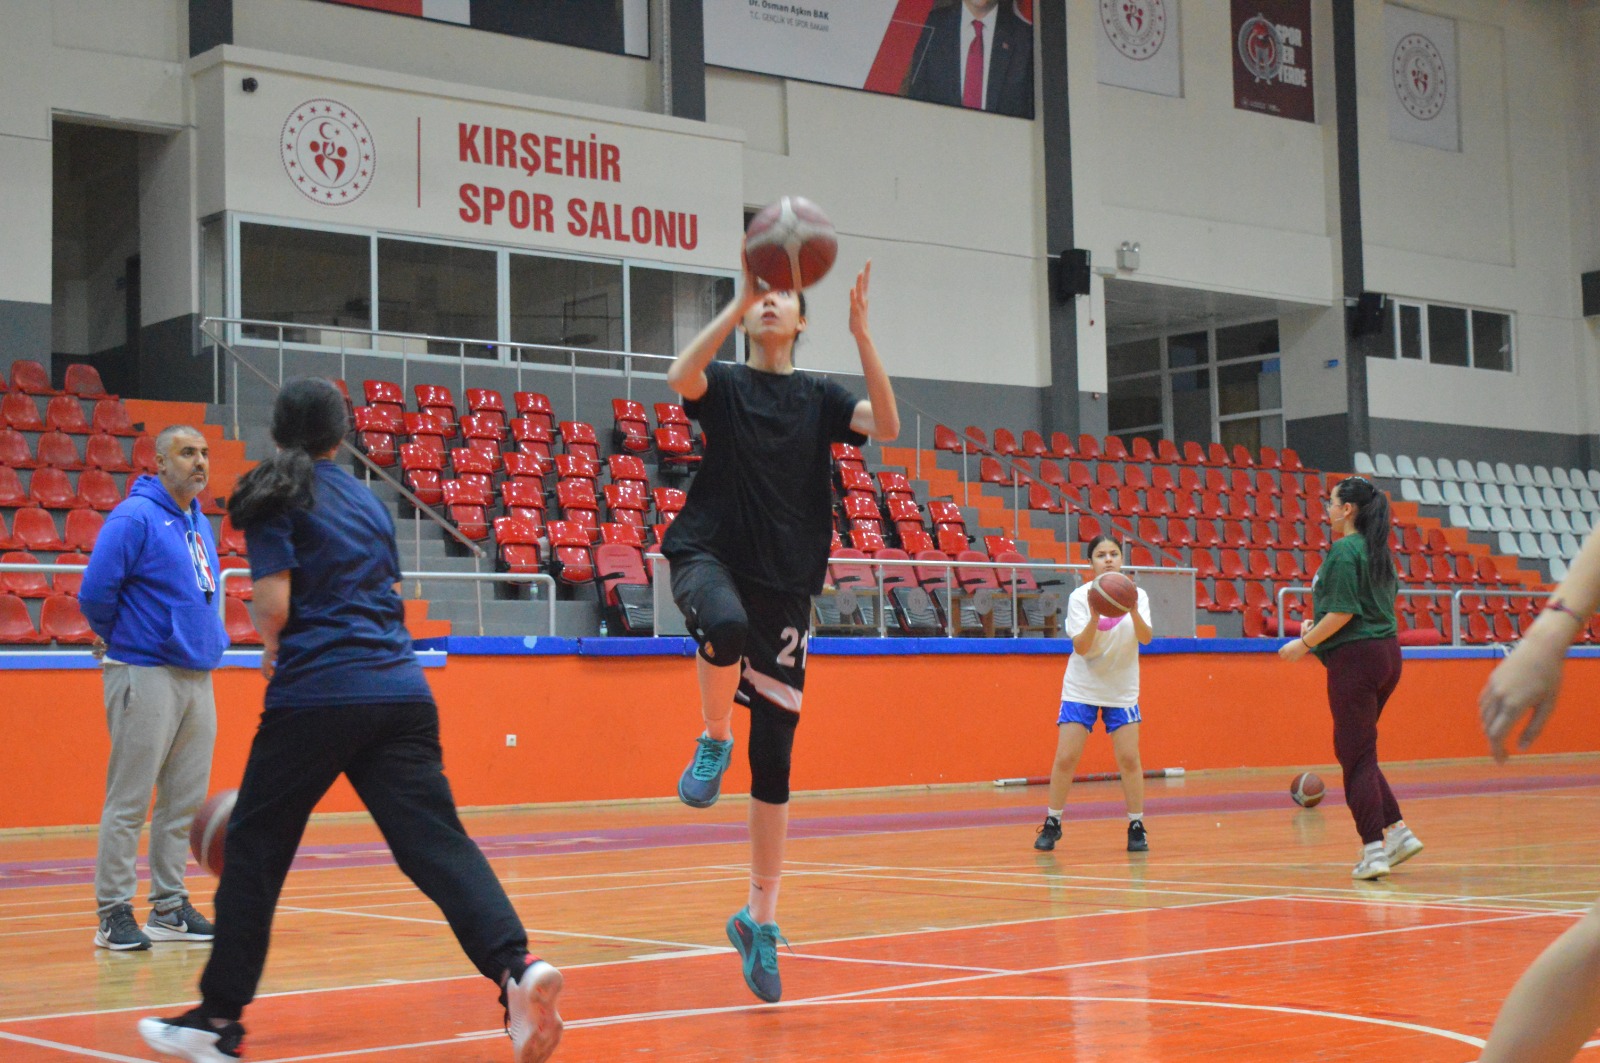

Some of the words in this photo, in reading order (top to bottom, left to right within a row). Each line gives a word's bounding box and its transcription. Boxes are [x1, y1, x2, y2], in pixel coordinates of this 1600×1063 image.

[762, 0, 789, 12] Osman
[791, 5, 812, 16] Aşkın
[813, 9, 829, 20] BAK
[458, 122, 621, 183] KIRŞEHİR
[458, 183, 555, 233] SPOR
[567, 197, 698, 251] SALONU
[776, 626, 808, 669] 21
